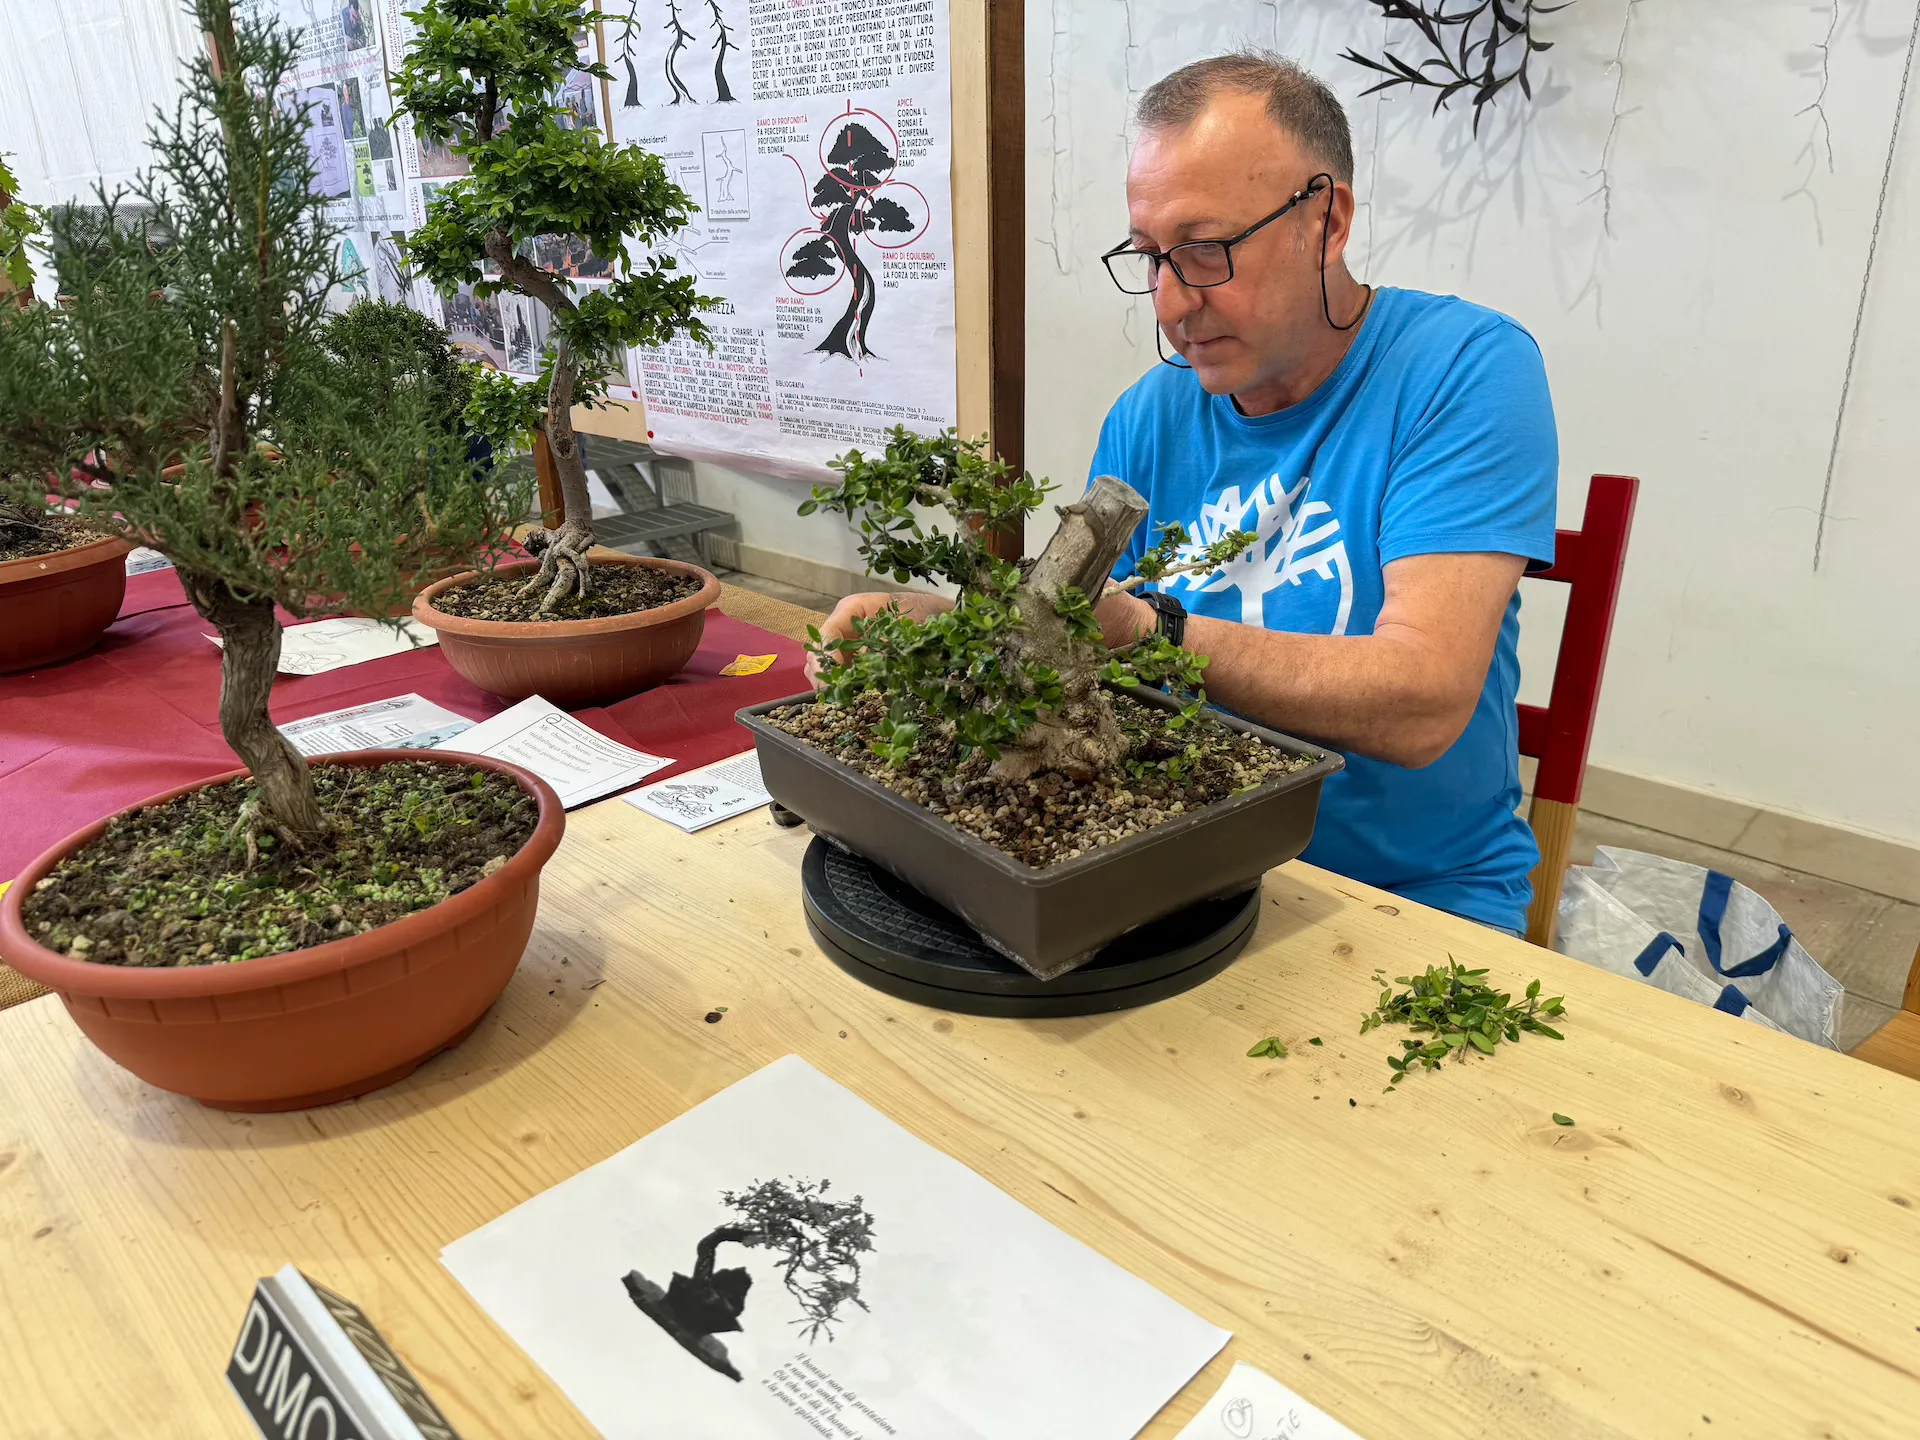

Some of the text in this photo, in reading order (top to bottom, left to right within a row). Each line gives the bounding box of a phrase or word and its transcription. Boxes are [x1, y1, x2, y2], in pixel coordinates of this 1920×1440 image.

[750, 1, 786, 15] RIGUARDA LA
[751, 11, 791, 26] SVILUPPANDOSI
[793, 8, 810, 20] VERSO
[812, 5, 831, 17] L'ALTO
[841, 0, 866, 12] TRONCO
[813, 17, 826, 28] NON
[829, 14, 843, 26] DEVE
[846, 9, 882, 22] PRESENTARE
[885, 1, 934, 17] RIGONFIAMENTI
[804, 29, 825, 41] DISEGNI
[834, 25, 850, 37] LATO
[852, 20, 886, 34] MOSTRANO
[888, 19, 896, 29] LA
[898, 13, 934, 27] STRUTTURA
[752, 25, 934, 59] PRINCIPALE UN BONSAI VISTO DI FRONTE DAL LATO
[752, 58, 772, 69] DESTRO
[792, 54, 803, 64] DAL
[806, 51, 821, 63] LATO
[825, 48, 850, 60] SINISTRO
[872, 44, 883, 54] TRE
[903, 40, 910, 50] DI
[752, 69, 769, 80] OLTRE
[820, 62, 828, 72] LA
[862, 54, 892, 67] METTONO
[894, 53, 901, 63] IN
[903, 49, 935, 63] EVIDENZA
[753, 61, 935, 90] COME MOVIMENTO DEL BONSAI RIGUARDA LE DIVERSE
[813, 83, 846, 96] LARGHEZZA
[897, 98, 912, 107] APICE
[897, 108, 921, 118] CORONA
[757, 114, 808, 126] RAMO PROFONDITÀ
[897, 118, 918, 128] BONSAI
[765, 126, 789, 136] PERCEPIRE
[898, 128, 928, 137] CONFERMA
[639, 134, 669, 145] indesiderati
[758, 134, 809, 145] PROFONDITÀ SPAZIALE
[906, 137, 934, 147] DIREZIONE
[758, 145, 785, 154] DEL BONSAI
[899, 148, 927, 158] DEL PRIMO
[899, 159, 915, 168] RAMO
[882, 252, 936, 260] RAMO EQUILIBRIO
[883, 261, 946, 271] BILANCIA OTTICAMENTE
[883, 271, 938, 280] LA FORZA DEL PRIMO
[883, 280, 899, 288] RAMO
[775, 296, 805, 305] PRIMO RAMO
[776, 314, 824, 324] RUOLO PRIMARIO PER
[732, 327, 753, 337] CHIARIRE
[777, 322, 806, 331] IMPORTANZA
[731, 336, 758, 347] INDIVIDUARE
[723, 344, 746, 354] INTERESSE
[669, 348, 754, 364] DELLA RAMIFICAZIONE
[674, 357, 690, 366] QUELLA
[692, 359, 702, 368] CHE
[704, 360, 715, 369] CREA
[727, 363, 745, 373] NOSTRO
[749, 365, 768, 375] OCCHIO
[702, 378, 715, 387] DELLE
[718, 380, 733, 389] CURVE
[645, 379, 761, 401] QUESTA SCELTA PER METTERE EVIDENZA
[645, 387, 772, 411] DIREZIONE PRINCIPALE DELLA PIANTA GRAZIE PRIMO
[669, 398, 682, 407] ANCHE
[707, 404, 720, 413] DELLA
[721, 406, 740, 416] CHIOMA
[741, 408, 752, 417] CON
[758, 411, 774, 421] RAMO
[287, 708, 370, 732] OLMO CINESE
[561, 722, 583, 738] Lezione
[232, 1298, 362, 1440] DIMO
[789, 1366, 806, 1380] non
[805, 1377, 819, 1389] dà
[767, 1382, 779, 1393] la
[773, 1389, 797, 1408] pace
[802, 1357, 832, 1380] bonsai
[826, 1377, 844, 1393] non
[842, 1391, 858, 1403] dà
[852, 1399, 897, 1435] protezione
[785, 1380, 801, 1394] che
[800, 1390, 812, 1401] ci
[808, 1398, 823, 1411] dà
[826, 1413, 857, 1438] bonsai
